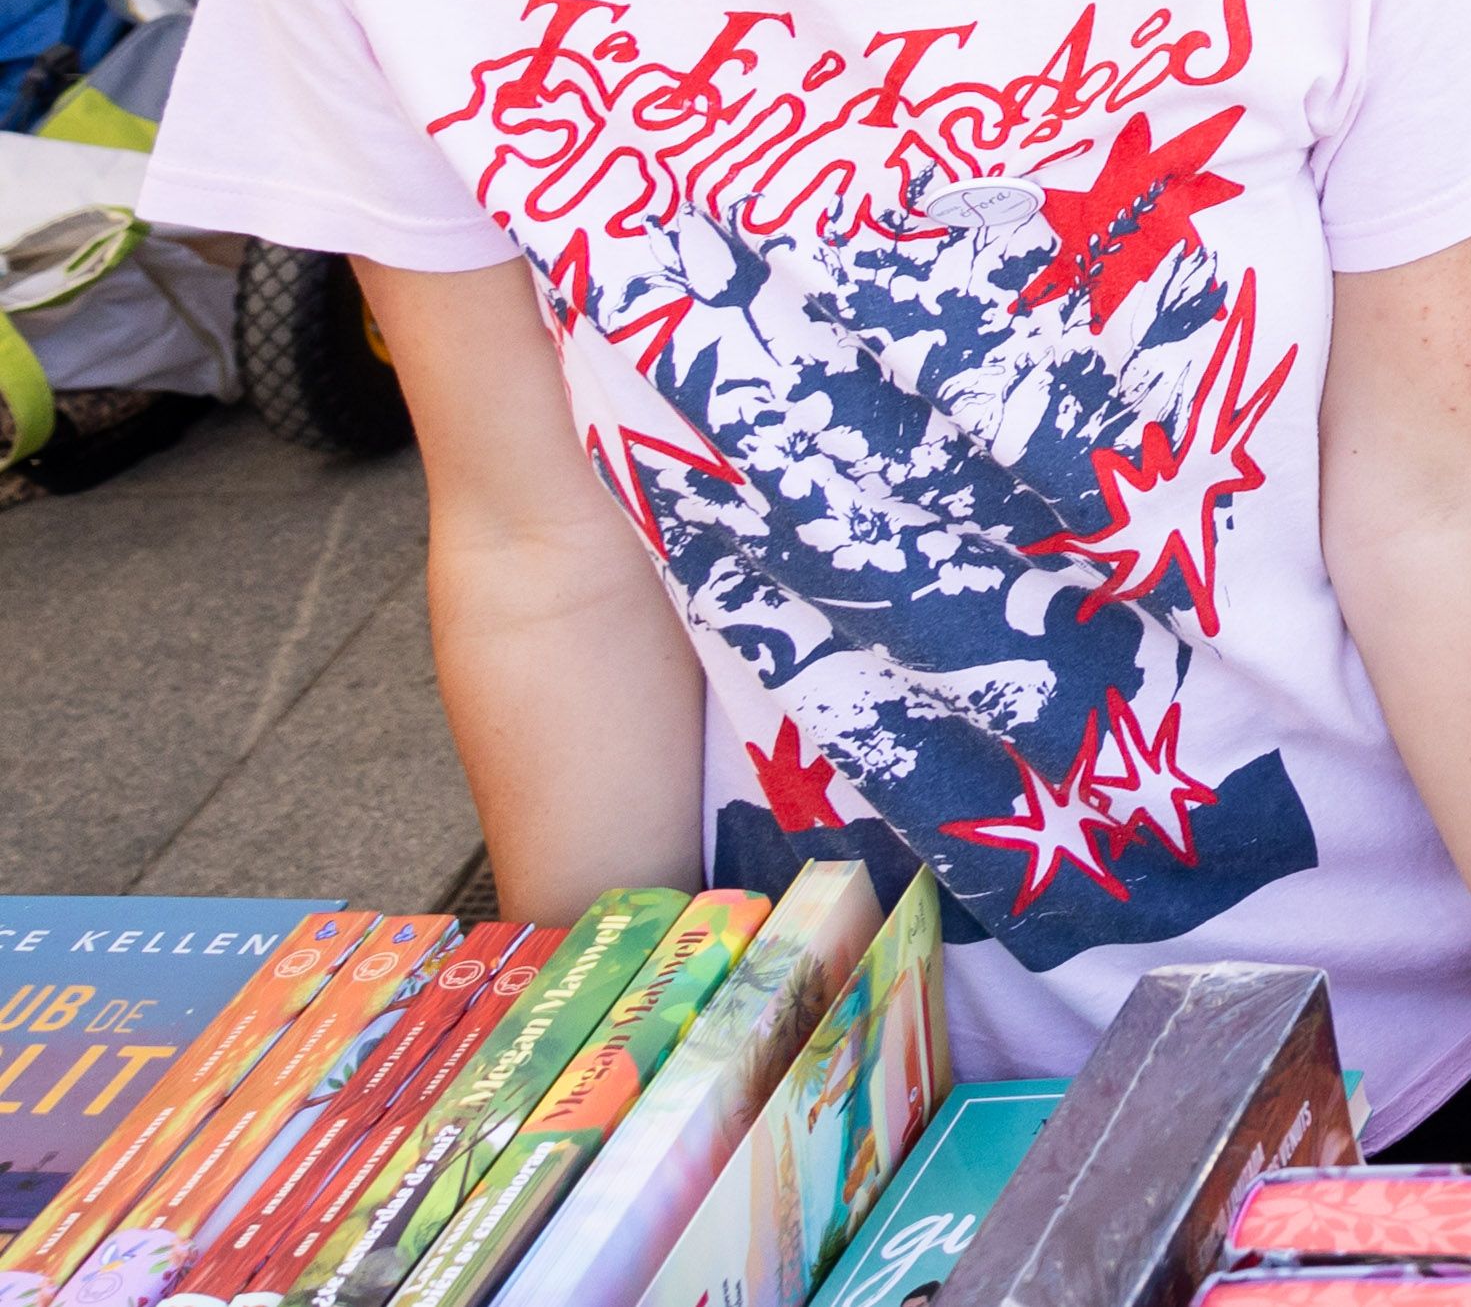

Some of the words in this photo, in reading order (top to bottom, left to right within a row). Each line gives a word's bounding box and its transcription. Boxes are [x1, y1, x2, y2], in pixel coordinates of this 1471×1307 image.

[70, 930, 279, 955] KELLEN
[85, 999, 159, 1033] DE
[458, 1008, 555, 1112] Megan
[530, 914, 633, 1016] Maxwell
[541, 1033, 632, 1122] Megan
[611, 930, 710, 1030] Maxwell
[336, 1186, 416, 1275] acuerdas
[404, 1160, 435, 1187] de
[453, 1240, 481, 1266] se
[472, 1141, 558, 1242] enamoran
